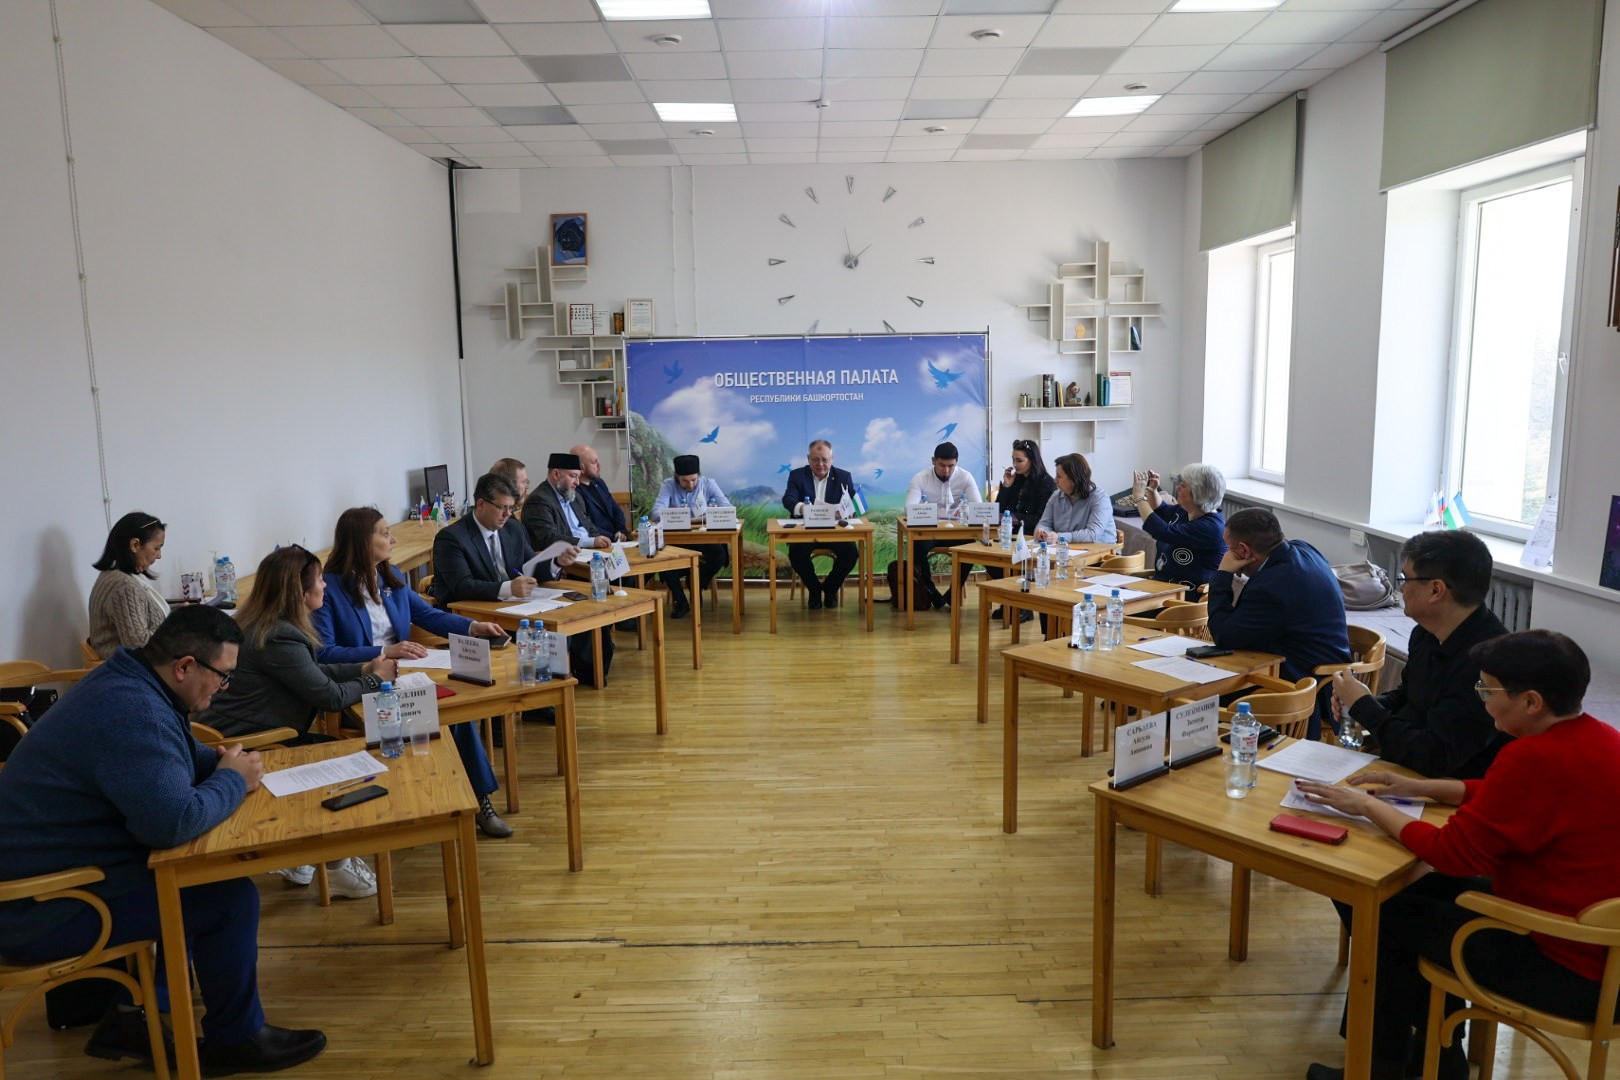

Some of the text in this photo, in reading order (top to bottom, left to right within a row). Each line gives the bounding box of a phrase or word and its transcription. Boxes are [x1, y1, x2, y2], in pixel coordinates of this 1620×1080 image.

[714, 368, 899, 389] ОБЩЕСТВЕННАЯ ПАЛАТА
[750, 392, 864, 404] РЕСПУБЛИКИ БАШКОРТОСТАН
[1175, 701, 1216, 720] СУЛЕЙМАНОВ
